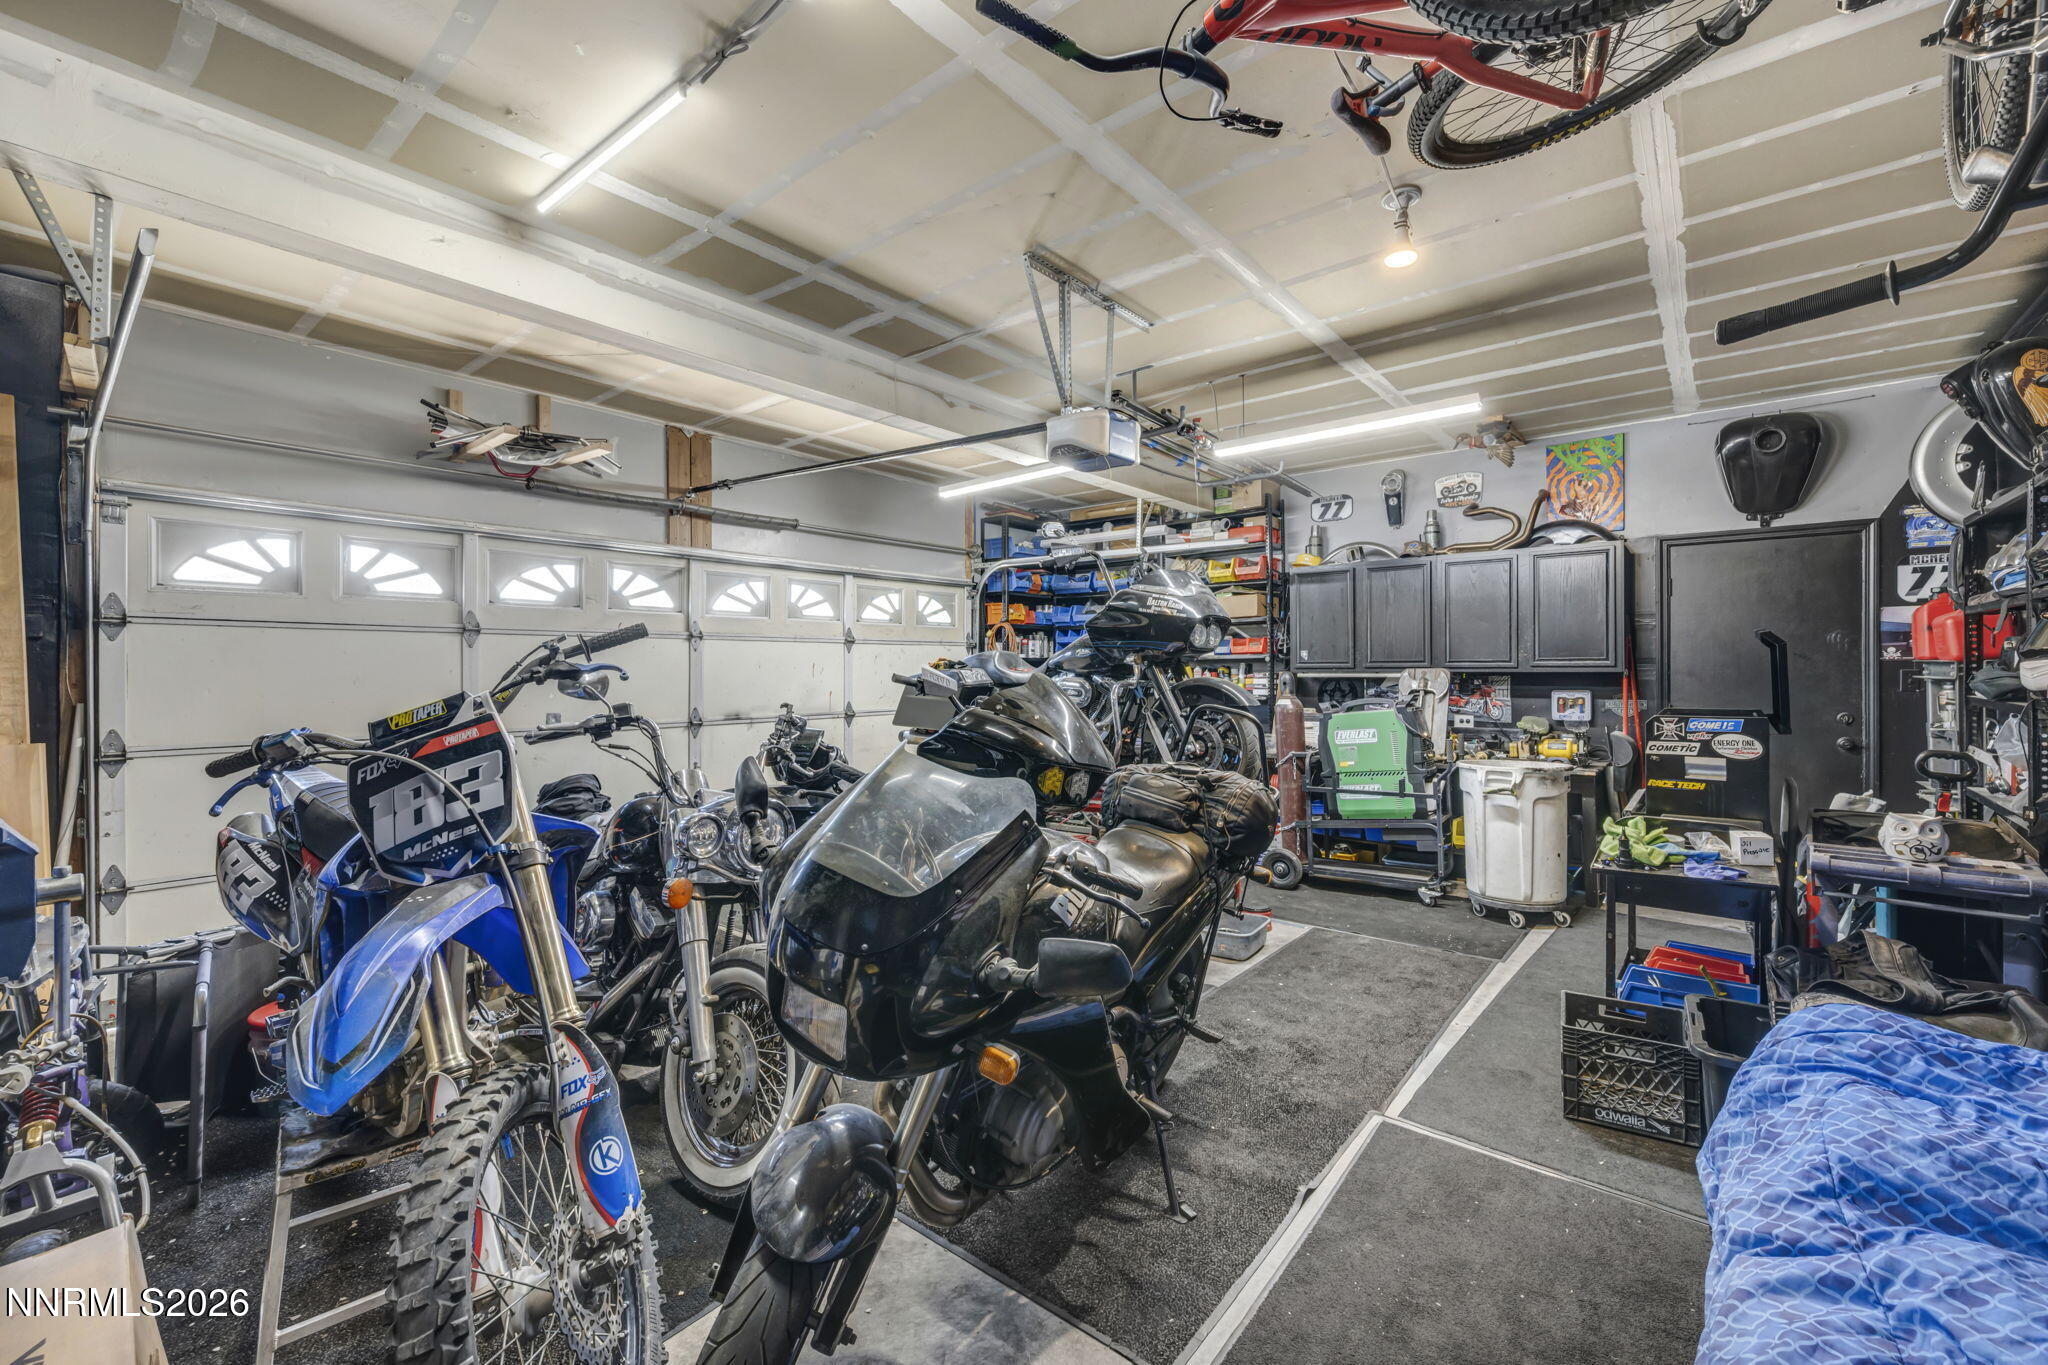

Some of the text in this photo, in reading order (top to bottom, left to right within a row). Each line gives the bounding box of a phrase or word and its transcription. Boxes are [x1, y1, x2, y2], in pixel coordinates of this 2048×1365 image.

[1318, 501, 1346, 519] 77
[391, 701, 443, 728] PROTAPER
[1337, 730, 1374, 739] EVERLAST
[356, 758, 388, 786] FOX
[404, 823, 480, 861] McNee
[248, 840, 281, 872] McNeel
[561, 1075, 588, 1100] FOX
